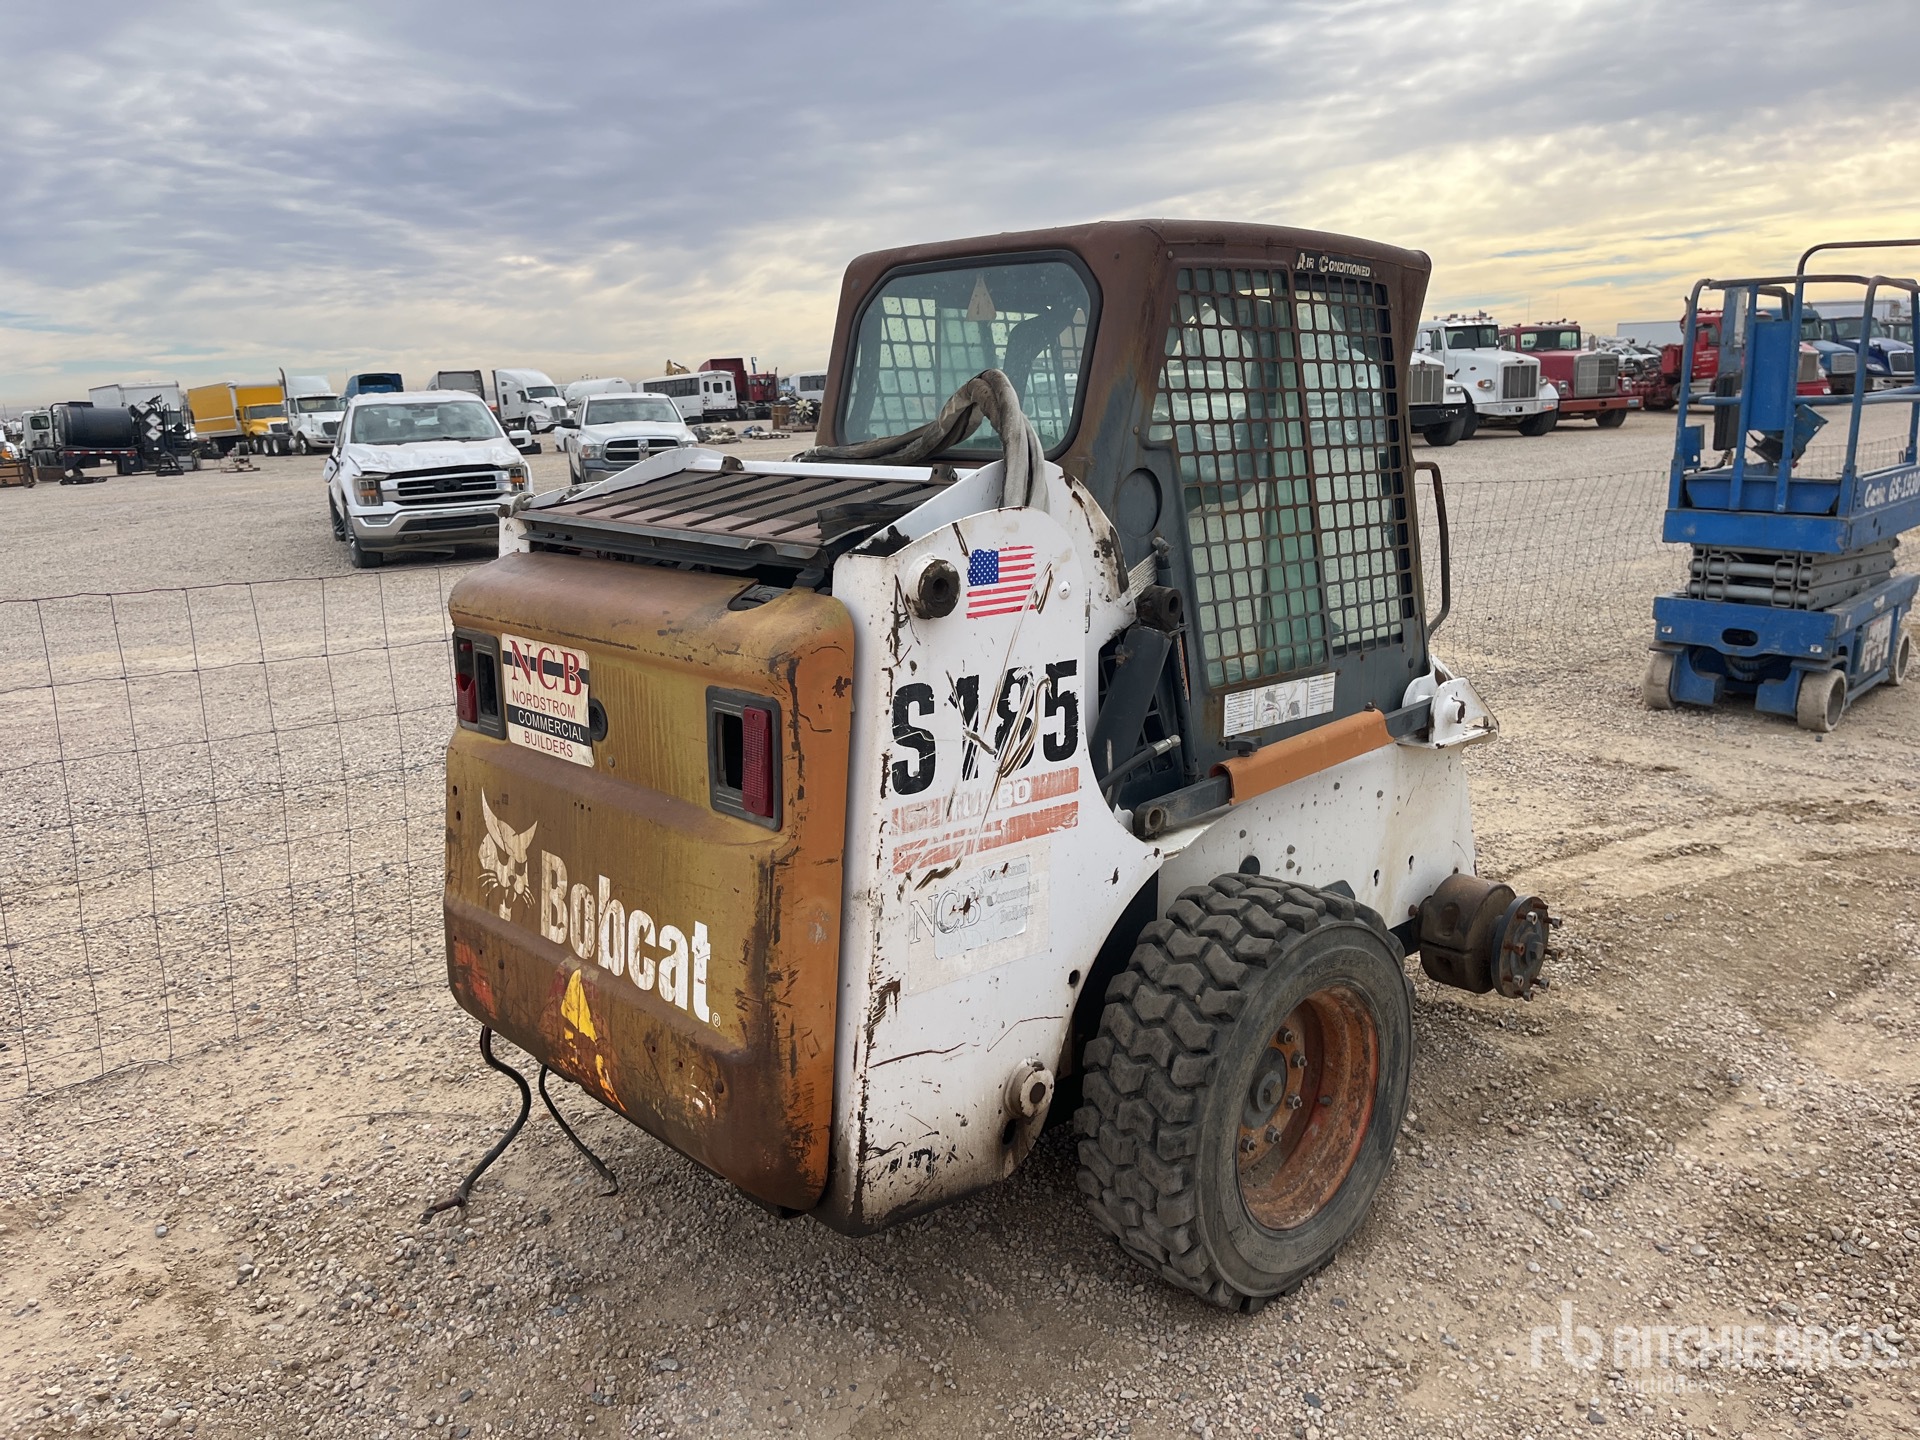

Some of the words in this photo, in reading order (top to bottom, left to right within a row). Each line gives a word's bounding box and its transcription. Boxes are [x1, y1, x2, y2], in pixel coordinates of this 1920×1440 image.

[1296, 252, 1315, 270] AIR
[1319, 256, 1371, 277] CONDITIONED
[509, 640, 582, 696] NCB
[512, 689, 576, 719] NORDSTROM
[518, 710, 584, 742] COMMERCIAL
[891, 659, 1079, 796] S185
[524, 731, 573, 757] BUILDERS
[541, 850, 711, 1023] Bobcat
